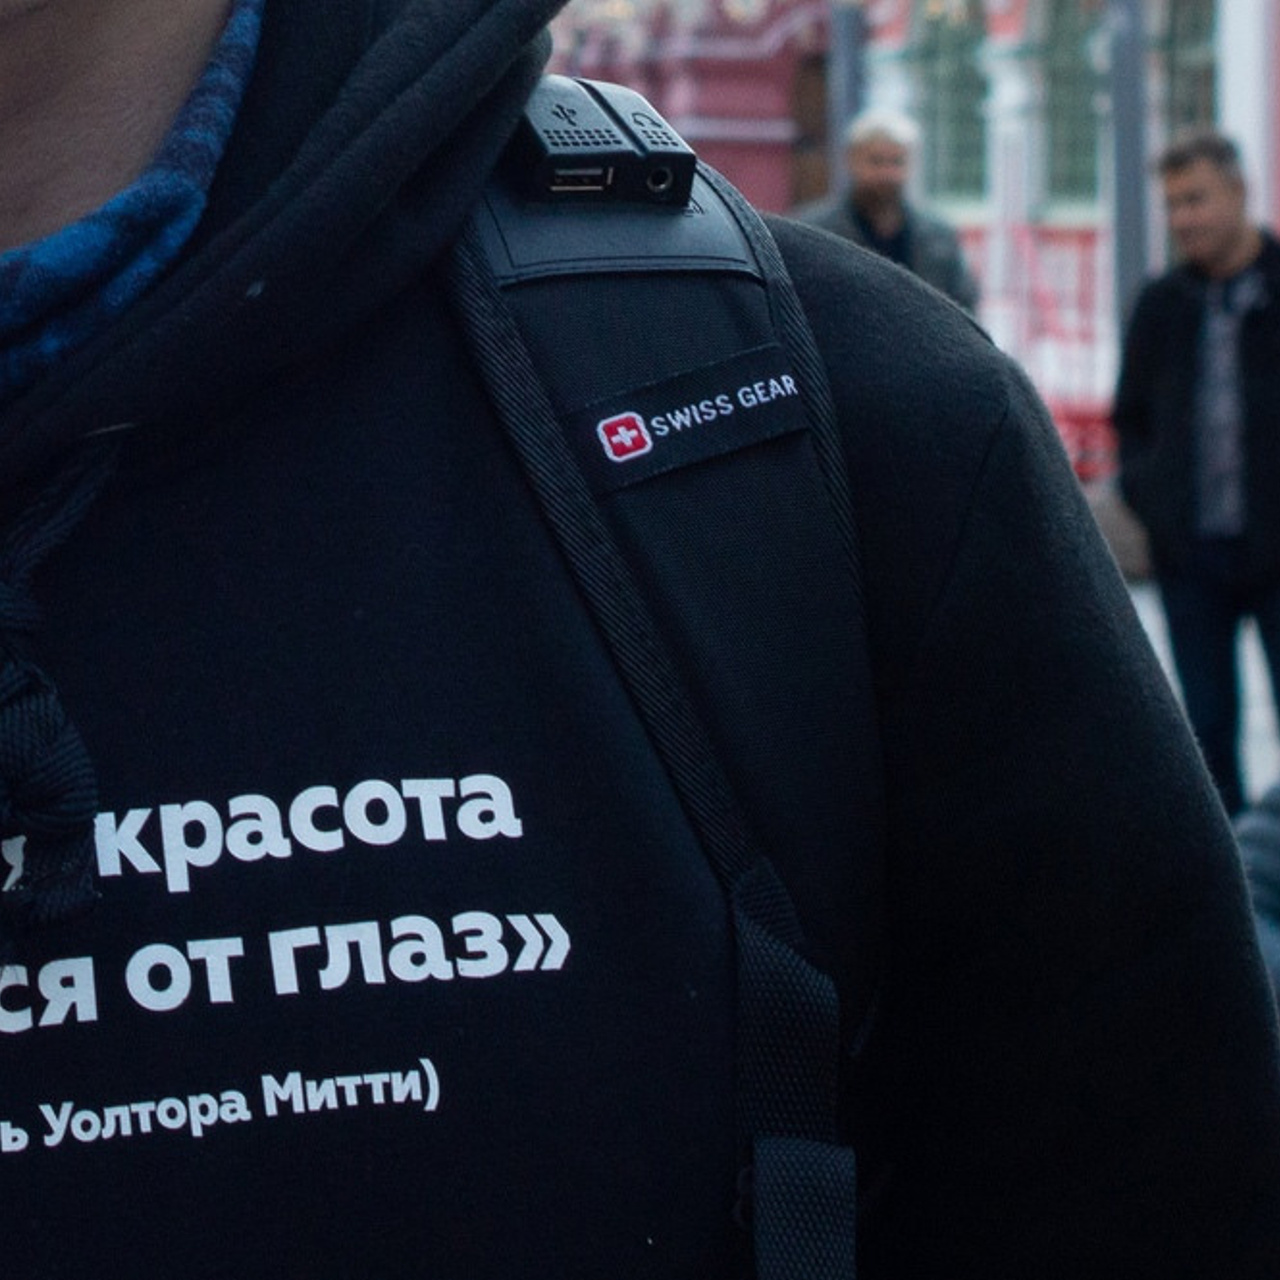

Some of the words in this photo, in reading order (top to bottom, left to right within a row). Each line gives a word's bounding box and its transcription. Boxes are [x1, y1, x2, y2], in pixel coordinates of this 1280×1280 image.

[650, 394, 734, 436] SWISS
[737, 374, 799, 408] GEAR
[93, 773, 524, 894] красота
[124, 936, 245, 1012] от
[267, 910, 572, 996] глаз»
[38, 1089, 253, 1147] Уолтора
[260, 1057, 440, 1117] Митти)
